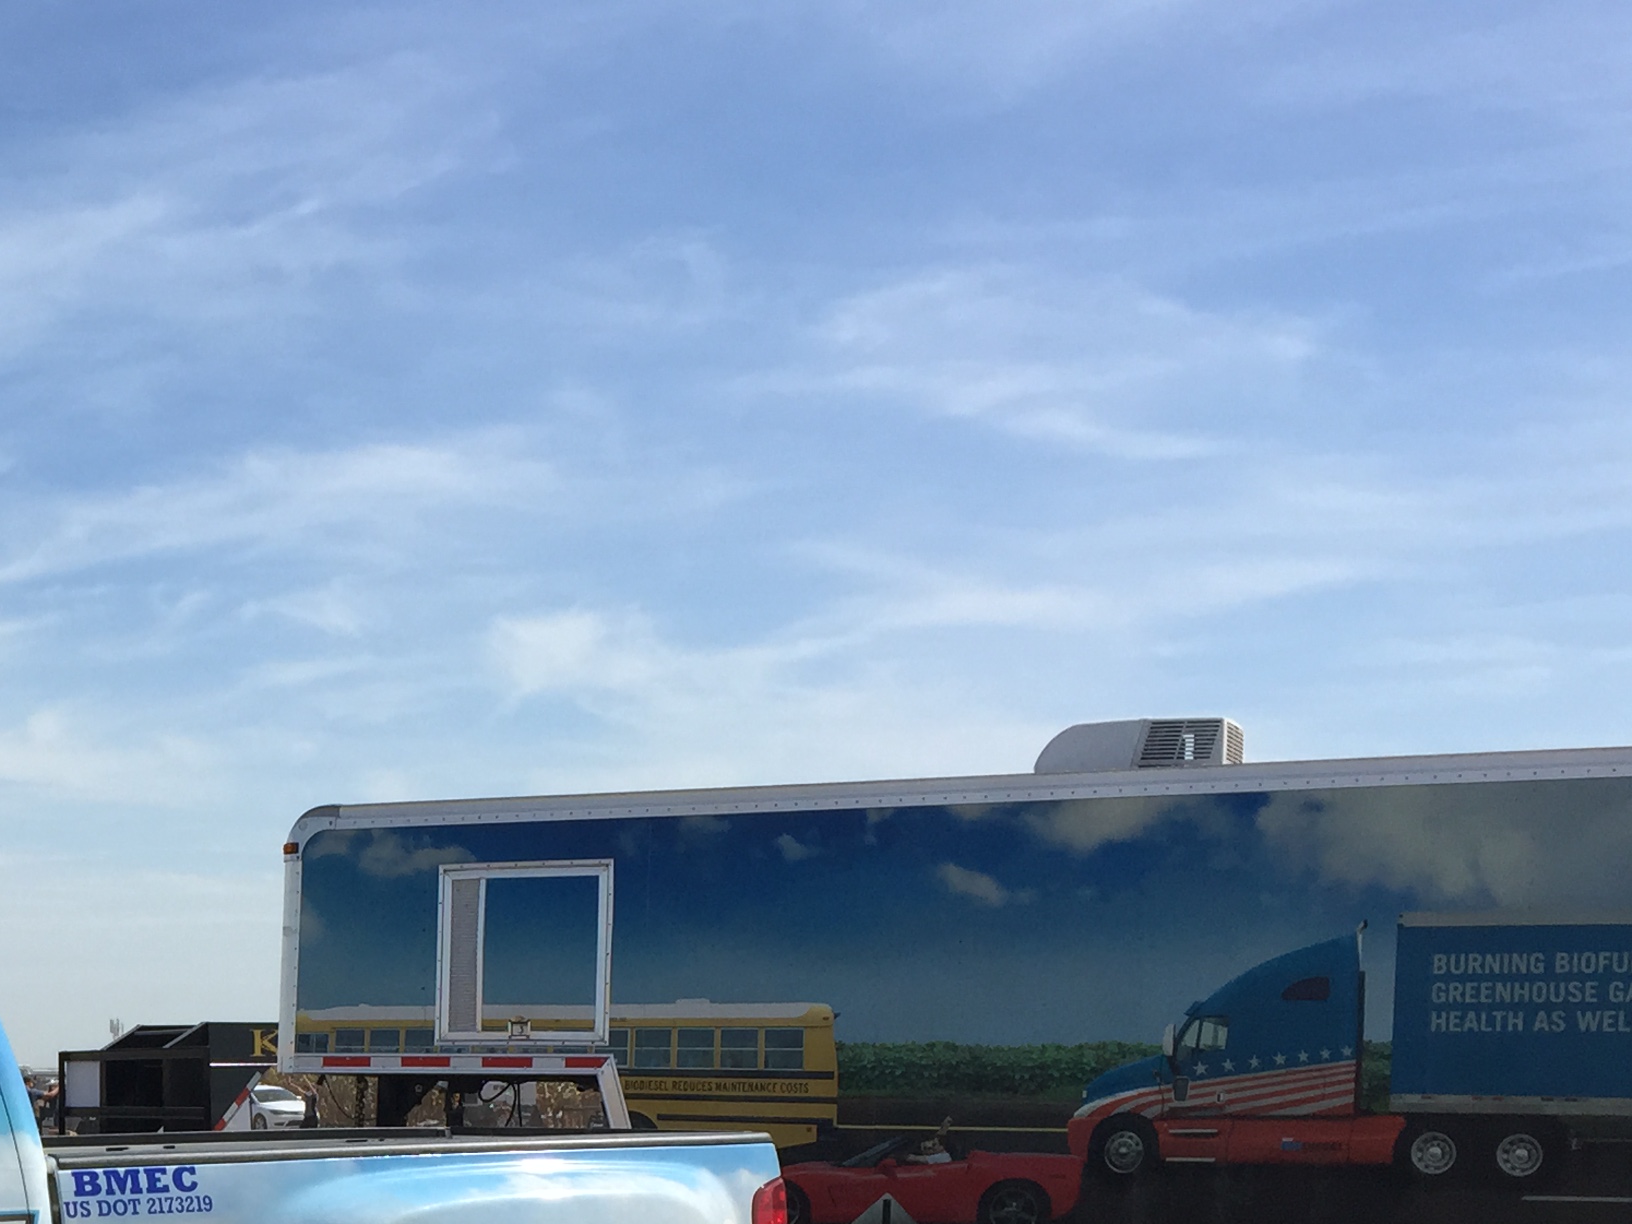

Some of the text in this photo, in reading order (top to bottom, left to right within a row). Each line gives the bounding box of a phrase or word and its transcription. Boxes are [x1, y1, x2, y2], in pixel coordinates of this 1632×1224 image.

[1432, 951, 1632, 975] BURNING BIOFU
[1431, 981, 1599, 1004] GREENHOUSE
[1430, 1010, 1524, 1033] HEALTH
[1533, 1009, 1567, 1033] AS
[624, 1079, 810, 1094] BIODIESEL REDUCES MAINTENANCE COSTS
[70, 1166, 199, 1197] BMEC
[64, 1194, 213, 1219] US DOT 2173219
